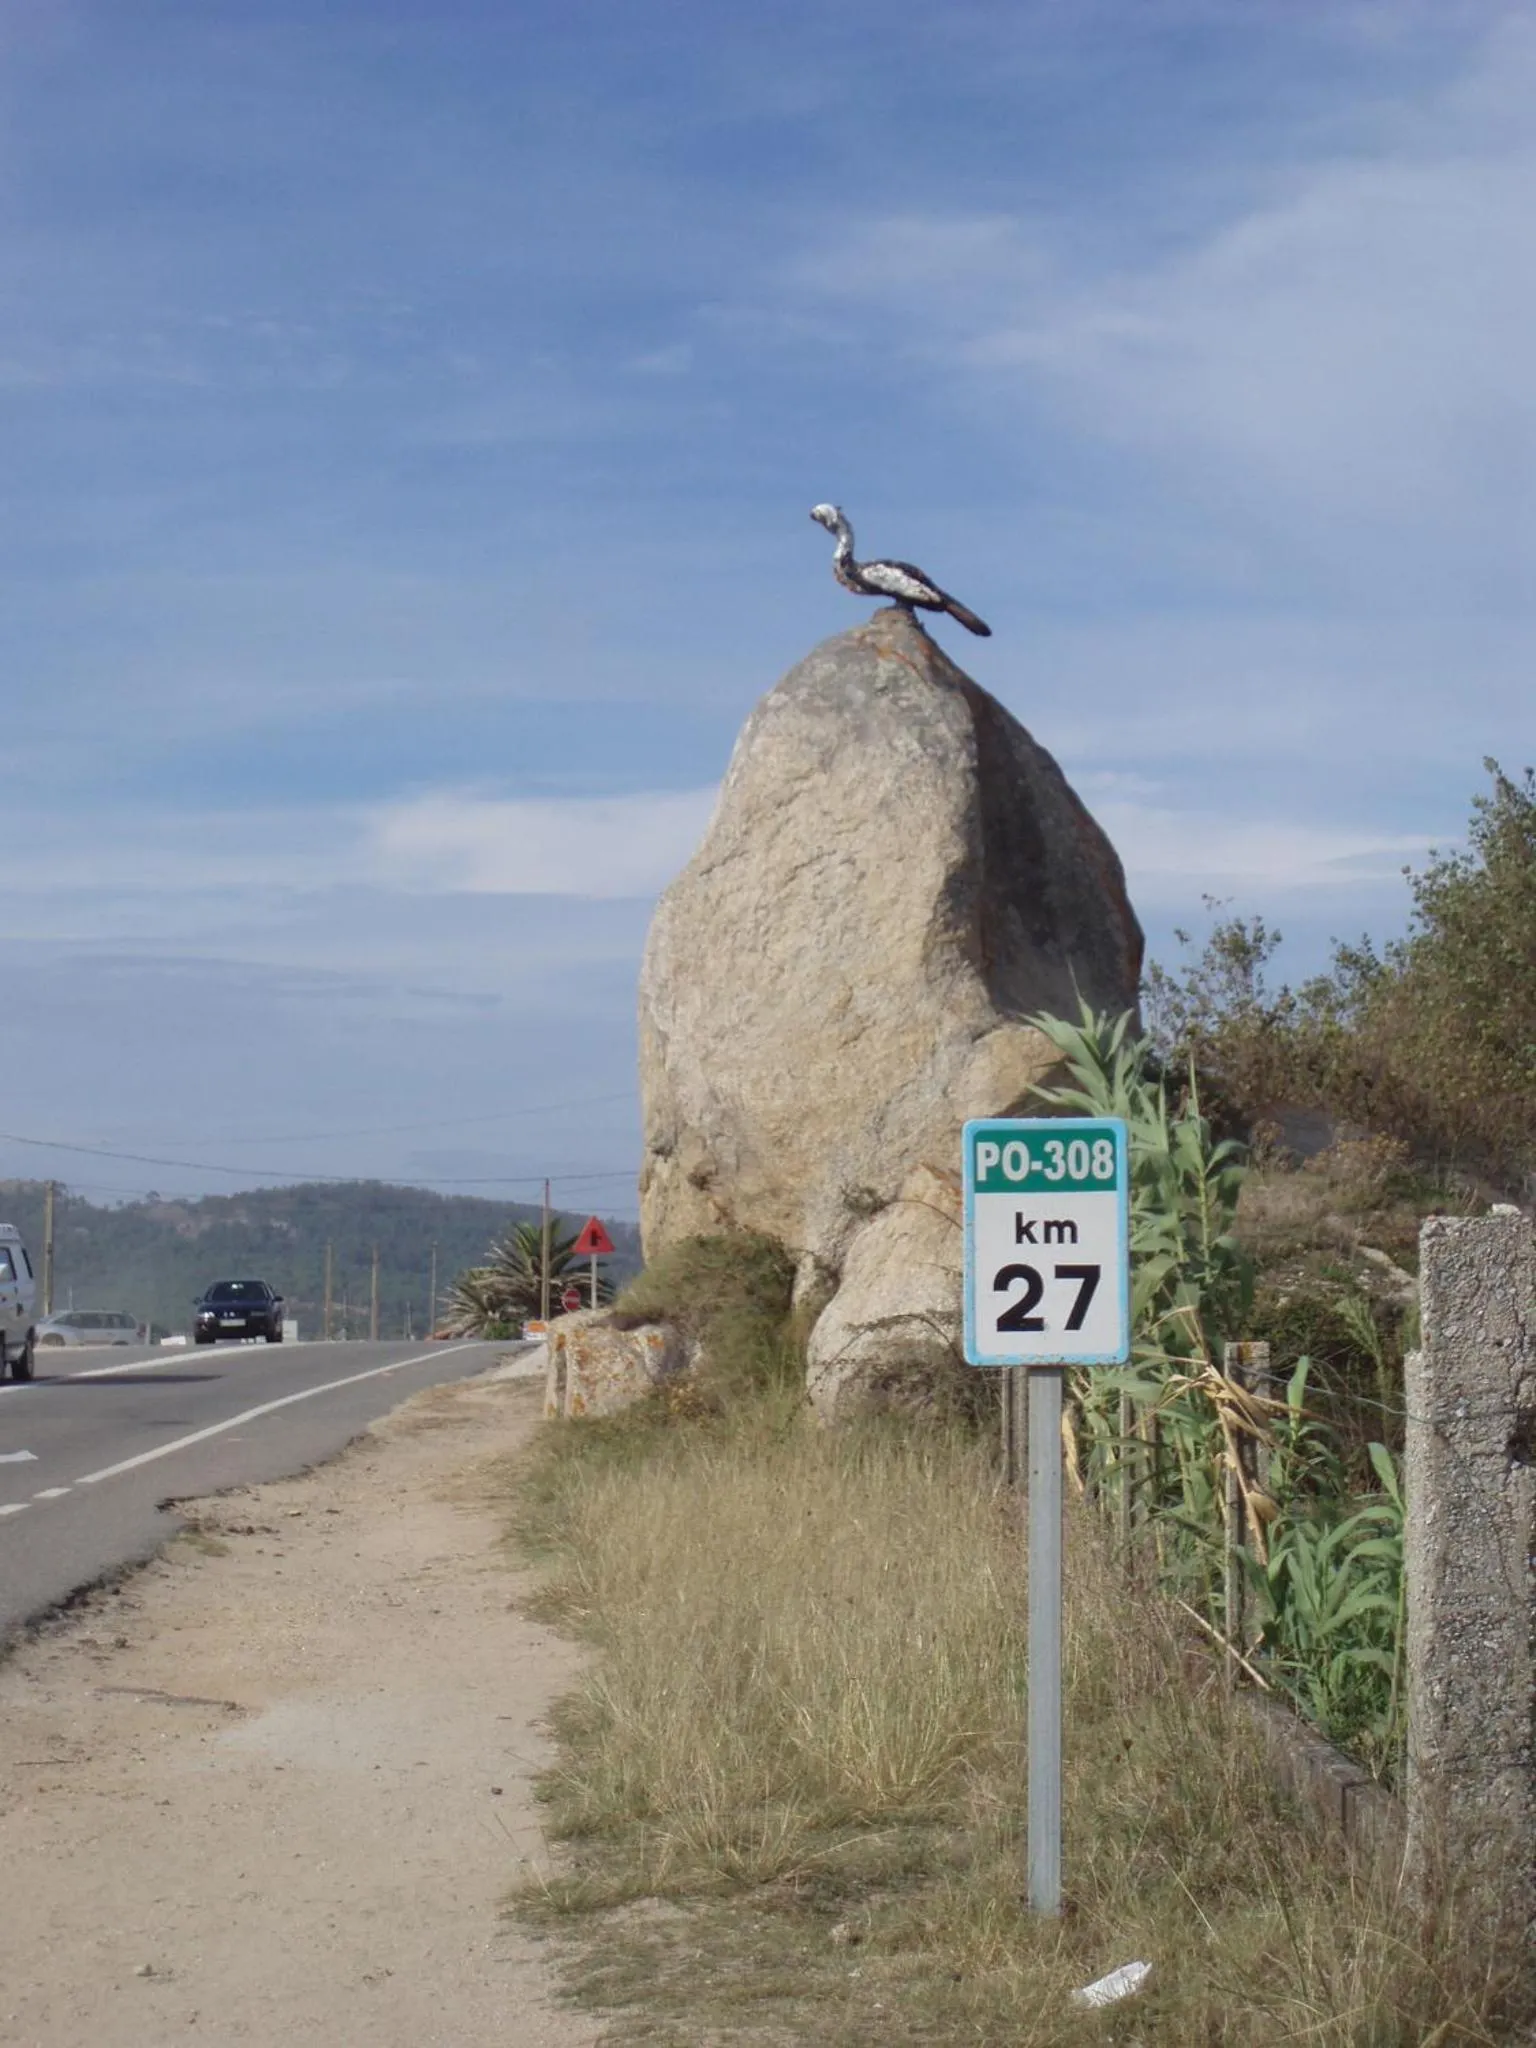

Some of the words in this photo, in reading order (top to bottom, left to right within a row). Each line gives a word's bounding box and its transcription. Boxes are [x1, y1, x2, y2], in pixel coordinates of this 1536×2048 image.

[975, 1139, 1114, 1182] PO-308
[1015, 1211, 1078, 1245] km
[993, 1263, 1101, 1332] 27
